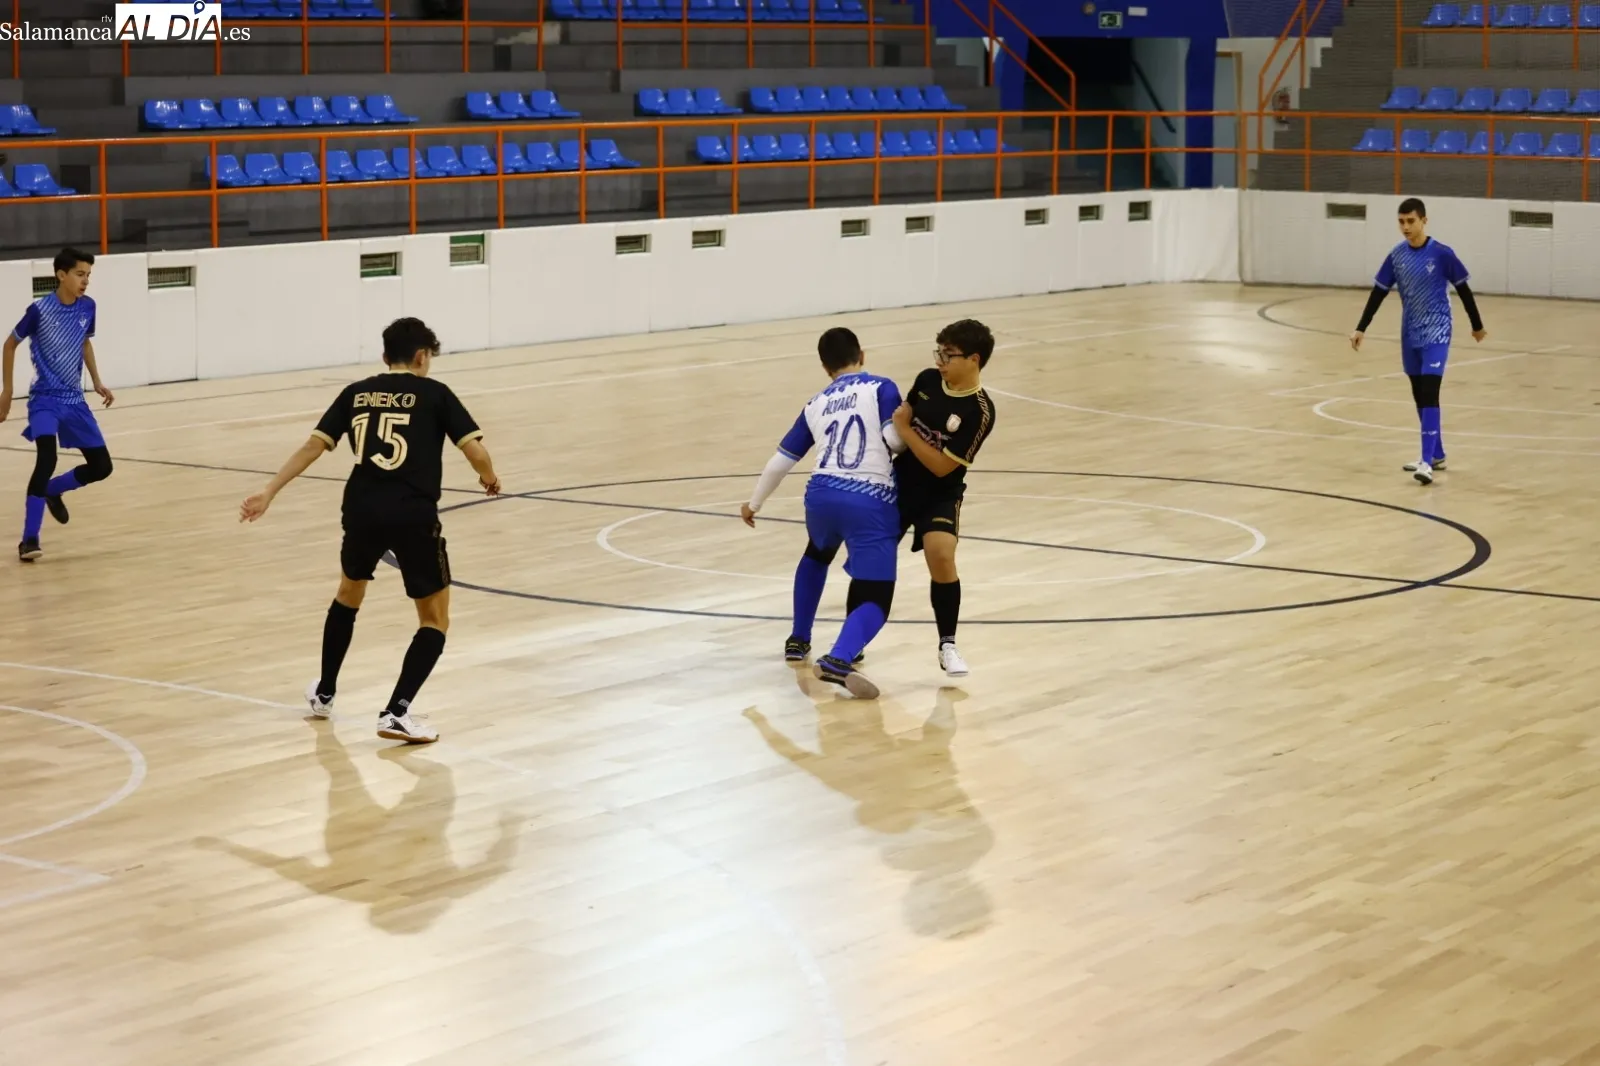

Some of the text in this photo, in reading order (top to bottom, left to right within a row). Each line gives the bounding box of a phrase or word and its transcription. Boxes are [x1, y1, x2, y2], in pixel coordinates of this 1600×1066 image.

[353, 391, 416, 408] ENEKO
[351, 412, 411, 470] 15
[819, 414, 866, 469] 10
